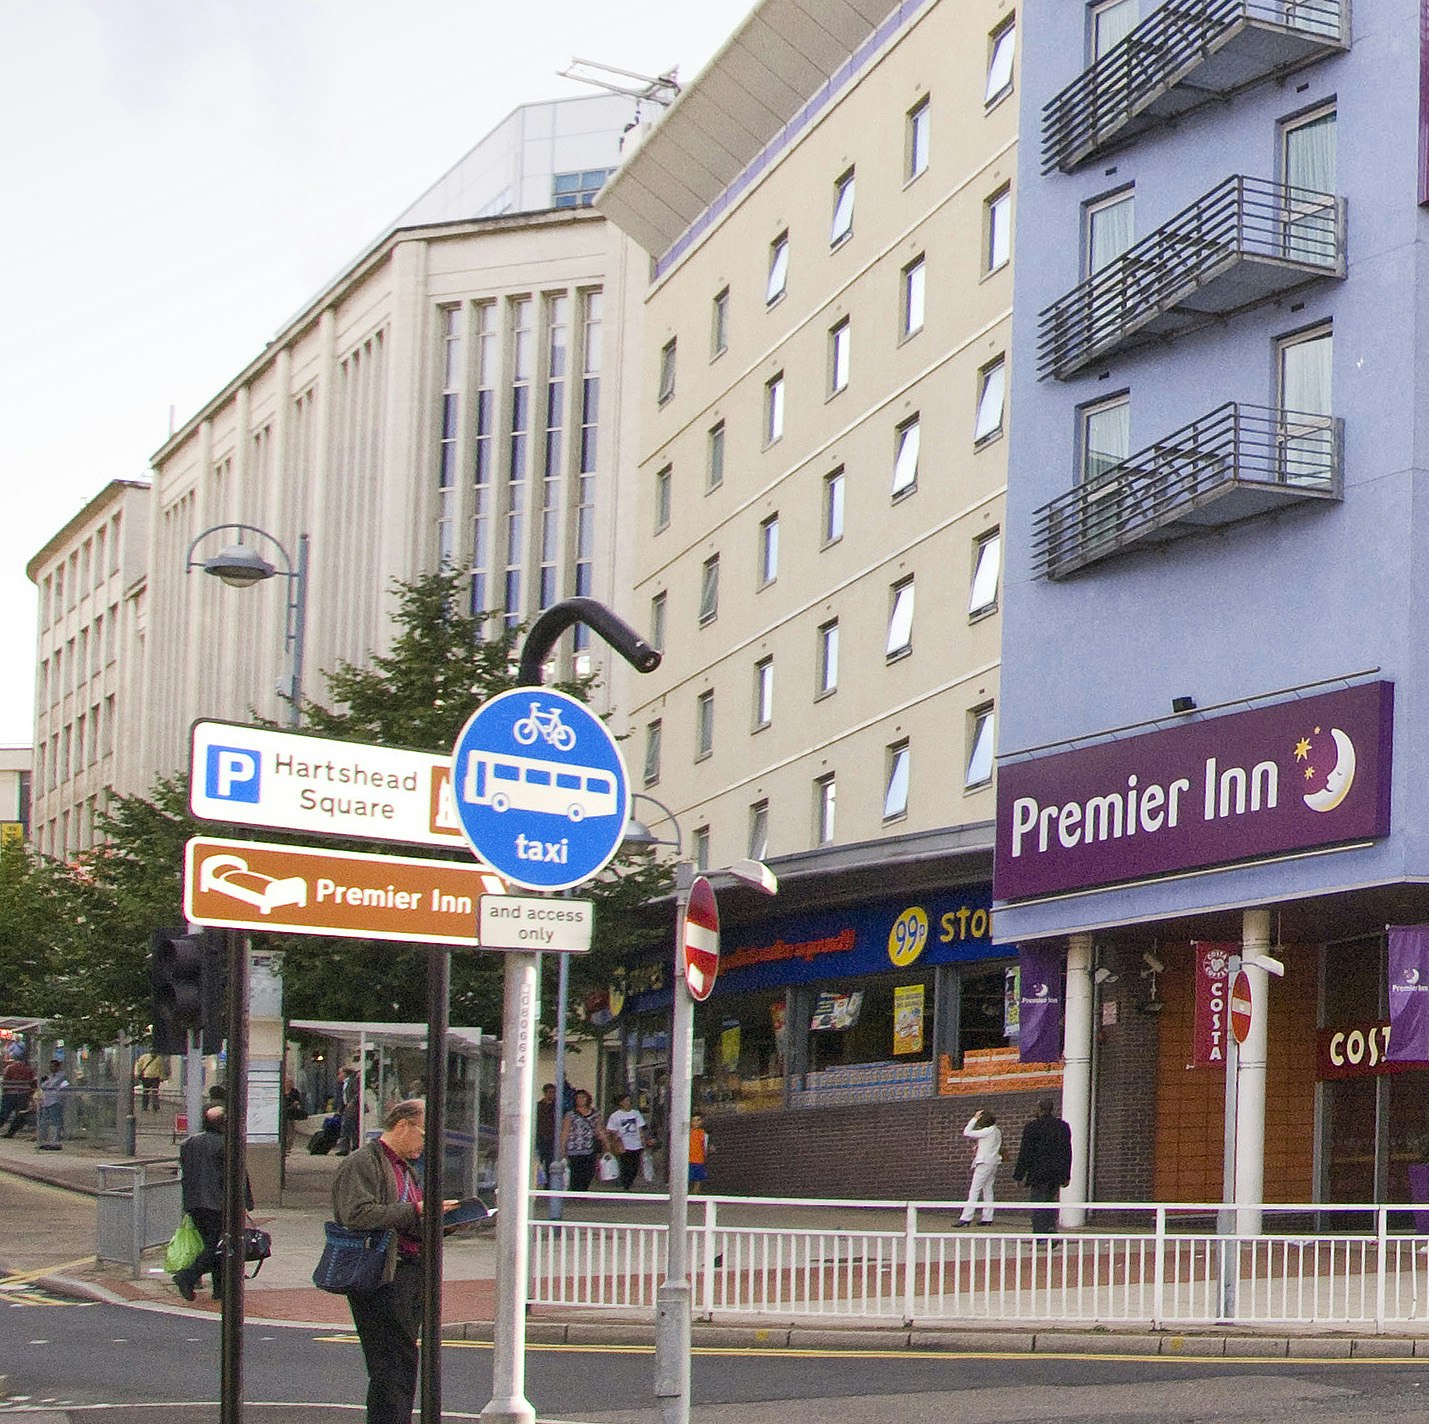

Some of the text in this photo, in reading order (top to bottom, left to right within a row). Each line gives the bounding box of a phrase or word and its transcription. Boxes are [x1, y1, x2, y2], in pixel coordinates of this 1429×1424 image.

[275, 753, 418, 792] Hartshead
[300, 788, 396, 820] Square
[1011, 757, 1279, 858] Premier Inn
[515, 833, 569, 864] taxi
[316, 878, 472, 914] Premier Inn
[490, 904, 584, 922] and access
[518, 926, 555, 944] only
[896, 914, 925, 957] 99p
[940, 906, 993, 943] STO
[1209, 982, 1224, 1061] COSTA
[1330, 1026, 1391, 1067] COST
